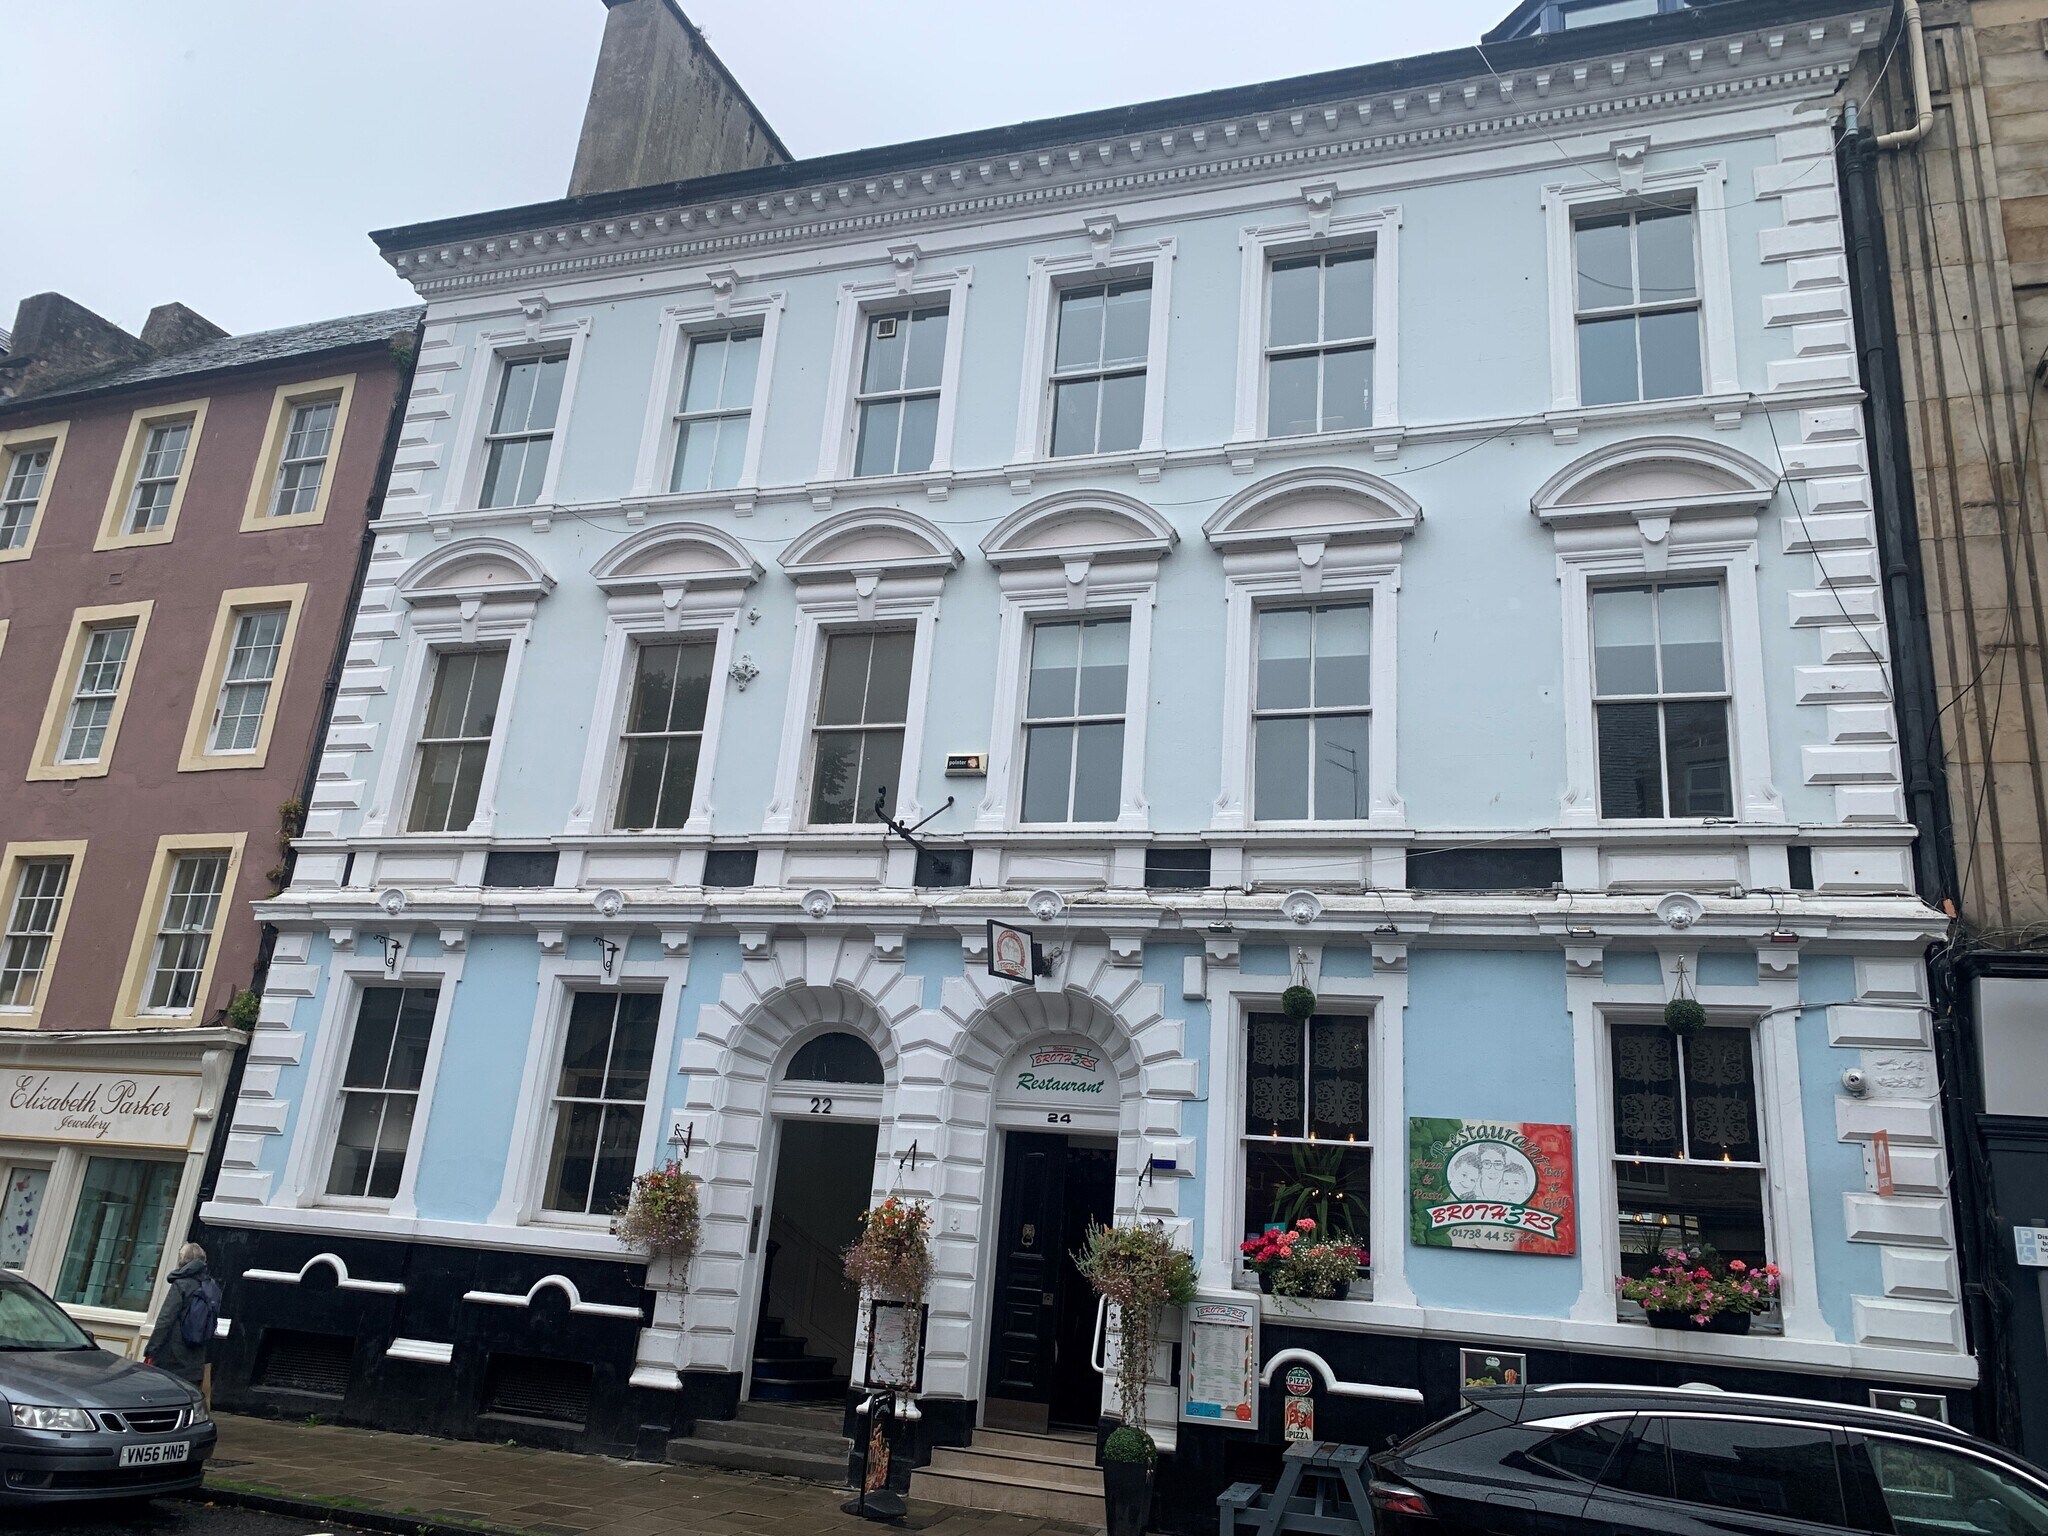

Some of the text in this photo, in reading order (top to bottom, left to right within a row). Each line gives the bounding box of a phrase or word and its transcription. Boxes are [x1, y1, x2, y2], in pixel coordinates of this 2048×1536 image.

[1035, 1053, 1095, 1068] BROTH3RS
[1016, 1073, 1105, 1093] Restaurant
[10, 1075, 172, 1117] Elizabeth Parker
[810, 1097, 832, 1114] 22
[1047, 1112, 1071, 1124] 24
[54, 1114, 111, 1138] Jewellery
[1430, 1124, 1550, 1166] Restaurant
[1413, 1158, 1443, 1170] Pizza
[1543, 1166, 1566, 1177] Bar
[1422, 1174, 1435, 1185] &
[1413, 1188, 1444, 1201] Pasta
[1549, 1182, 1560, 1193] &
[1542, 1196, 1570, 1210] Grill
[1432, 1204, 1554, 1231] BROTH3RS
[1452, 1228, 1481, 1240] 01738
[1484, 1230, 1500, 1242] 44
[1503, 1232, 1515, 1243] 55
[2020, 1230, 2032, 1244] P
[1289, 1376, 1310, 1385] PIZZA
[1289, 1431, 1309, 1440] PIZZA
[128, 1444, 184, 1463] VN56 HNB
